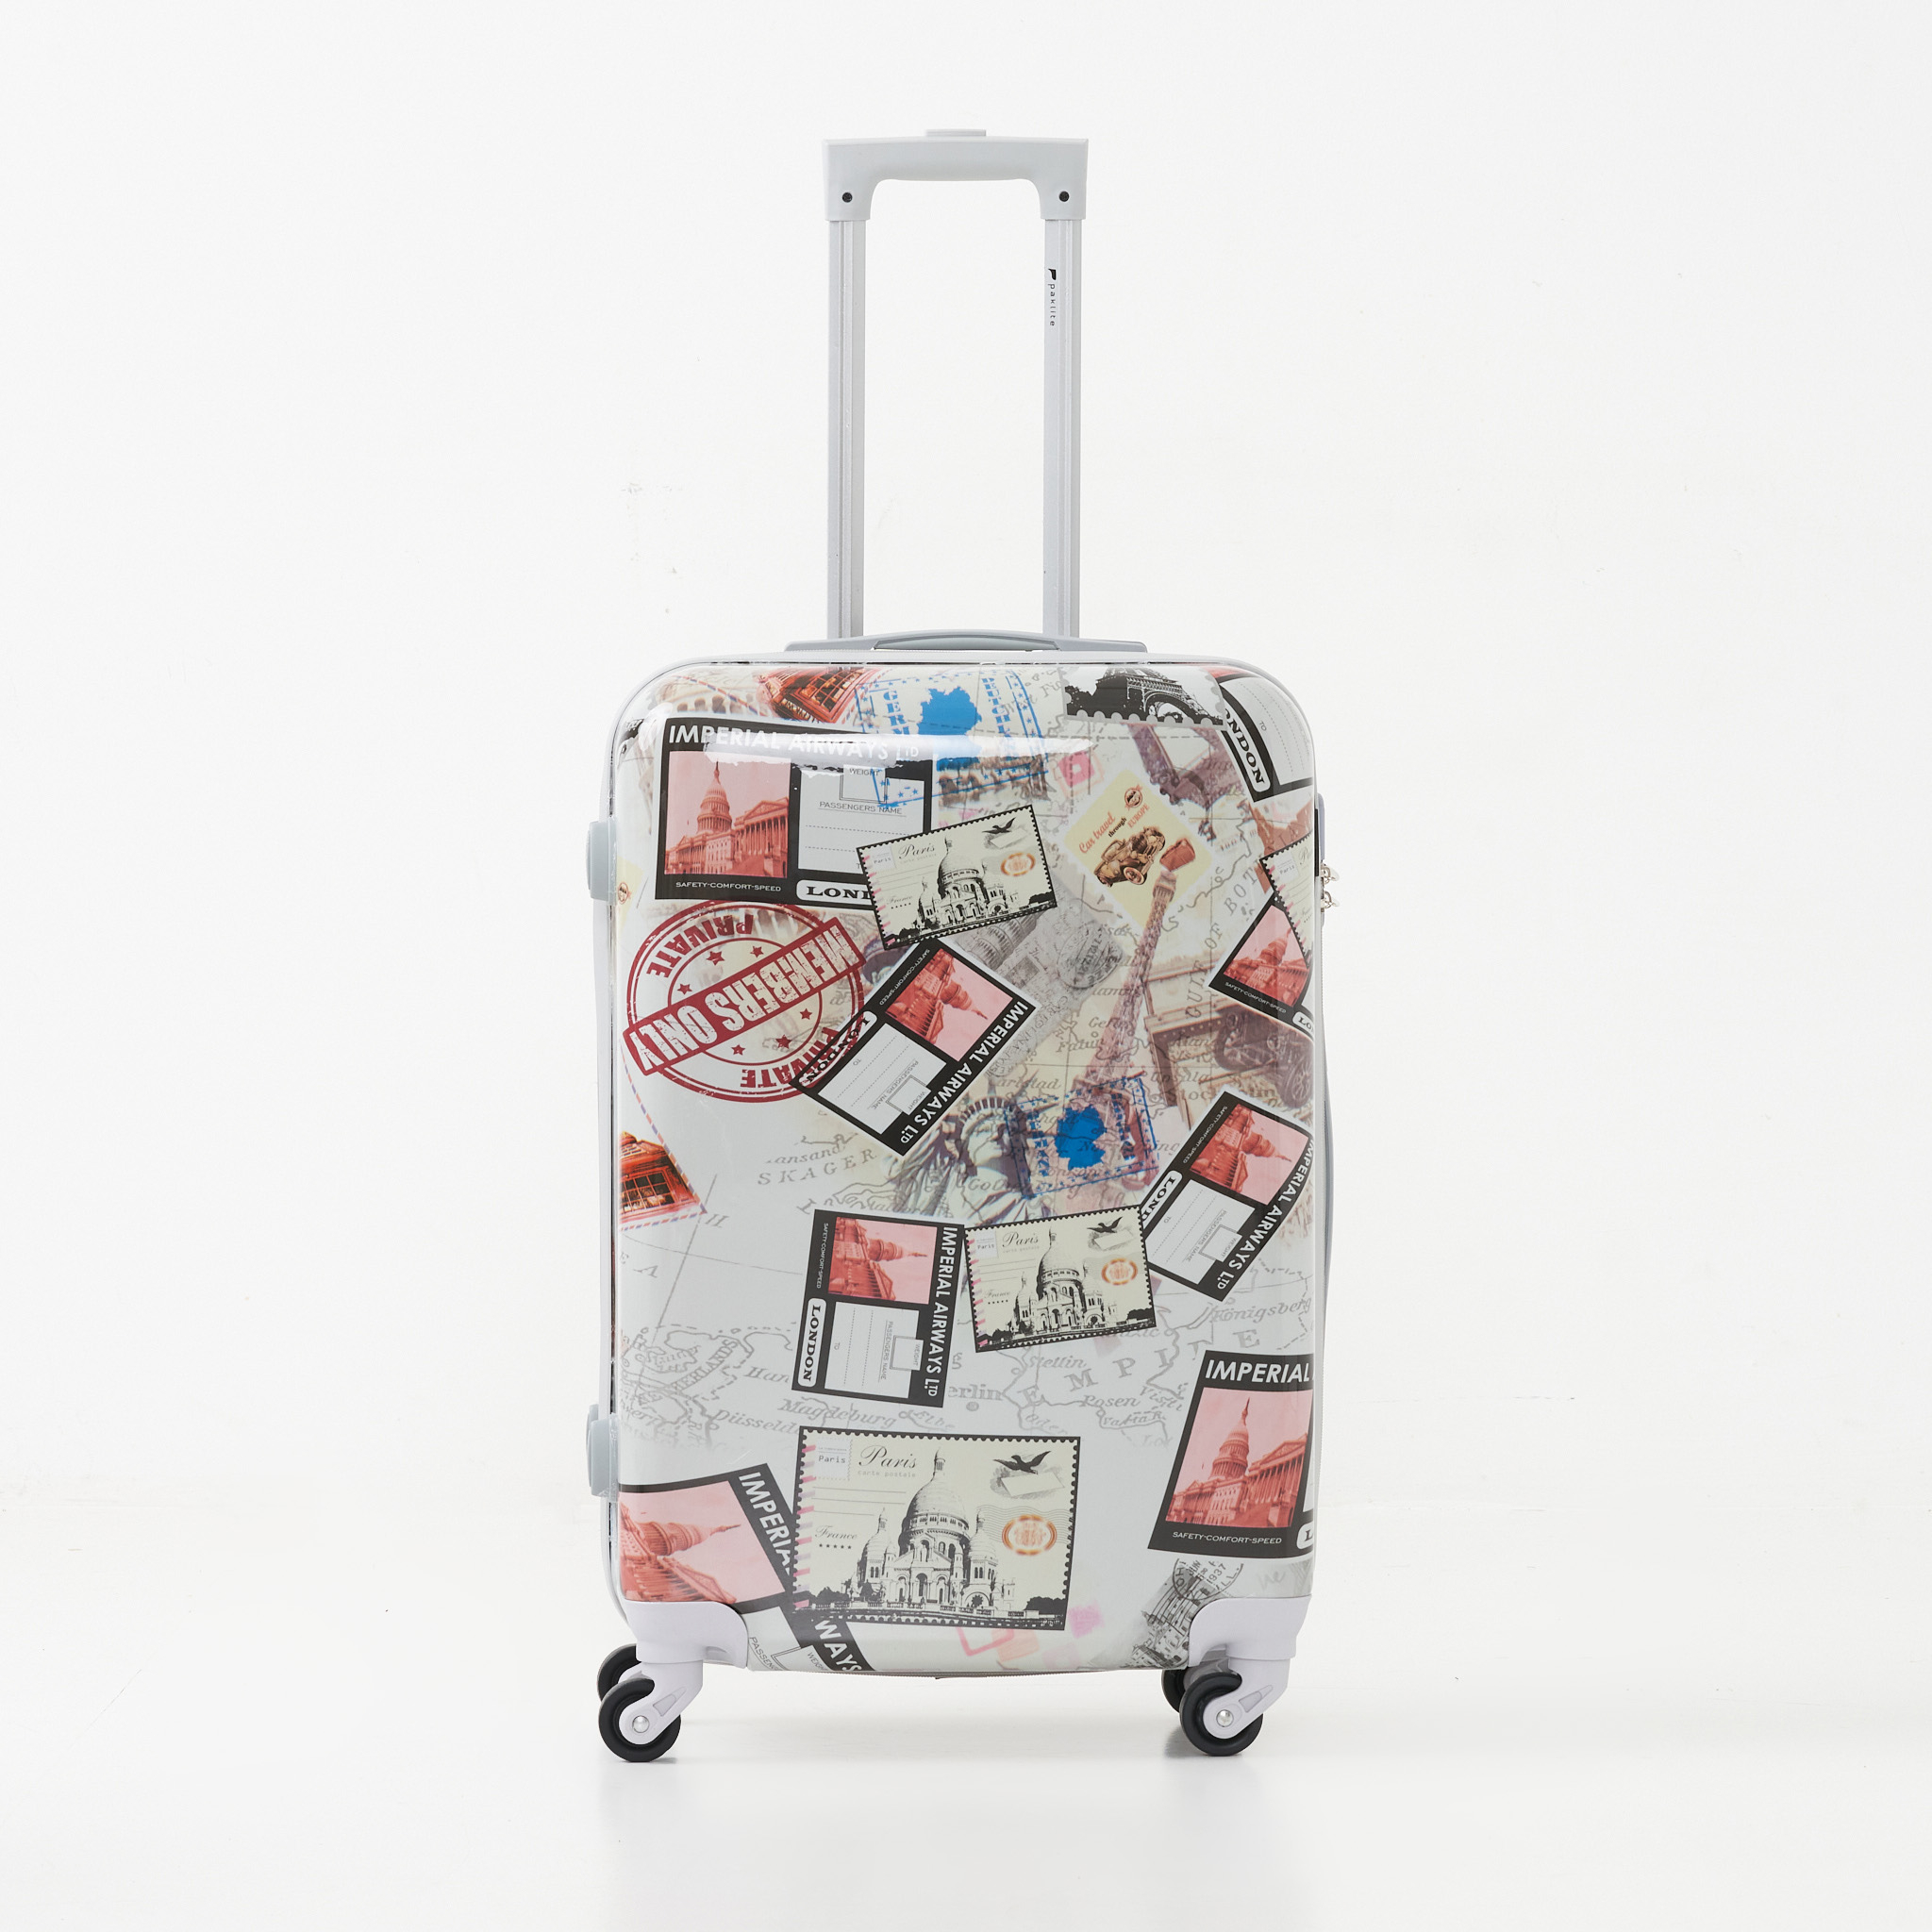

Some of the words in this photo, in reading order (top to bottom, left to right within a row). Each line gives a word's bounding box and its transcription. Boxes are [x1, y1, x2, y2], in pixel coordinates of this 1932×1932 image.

[1048, 283, 1057, 326] paklite
[1257, 721, 1267, 732] TO
[669, 724, 780, 751] IMPERIAL
[788, 733, 889, 760] AIRWAYS
[849, 768, 880, 776] WEIGHT
[819, 801, 876, 812] PASSENGERS
[878, 807, 903, 815] NAME
[1078, 840, 1095, 854] Car
[1093, 811, 1116, 842] travel
[1108, 817, 1127, 838] through
[899, 842, 935, 859] Paris
[647, 914, 755, 978] PRIVATE
[704, 925, 860, 1032] MEMBERS
[628, 1005, 718, 1072] ONLY
[969, 1001, 1029, 1063] IMPERIAL
[914, 1064, 973, 1126] AIRWAYS
[766, 1144, 845, 1164] ansand
[1002, 1231, 1040, 1248] Paris
[1228, 1204, 1283, 1270] AIRWAYS
[935, 1226, 958, 1298] IMPERIAL
[803, 1305, 821, 1381] LONDON
[925, 1302, 949, 1374] AIRWAYS
[1206, 1359, 1309, 1383] IMPERIAL
[777, 1400, 897, 1428] Magdeburg
[818, 1455, 846, 1463] Paris
[858, 1444, 917, 1469] Paris
[815, 1524, 858, 1540] France
[1207, 1563, 1226, 1585] 1937
